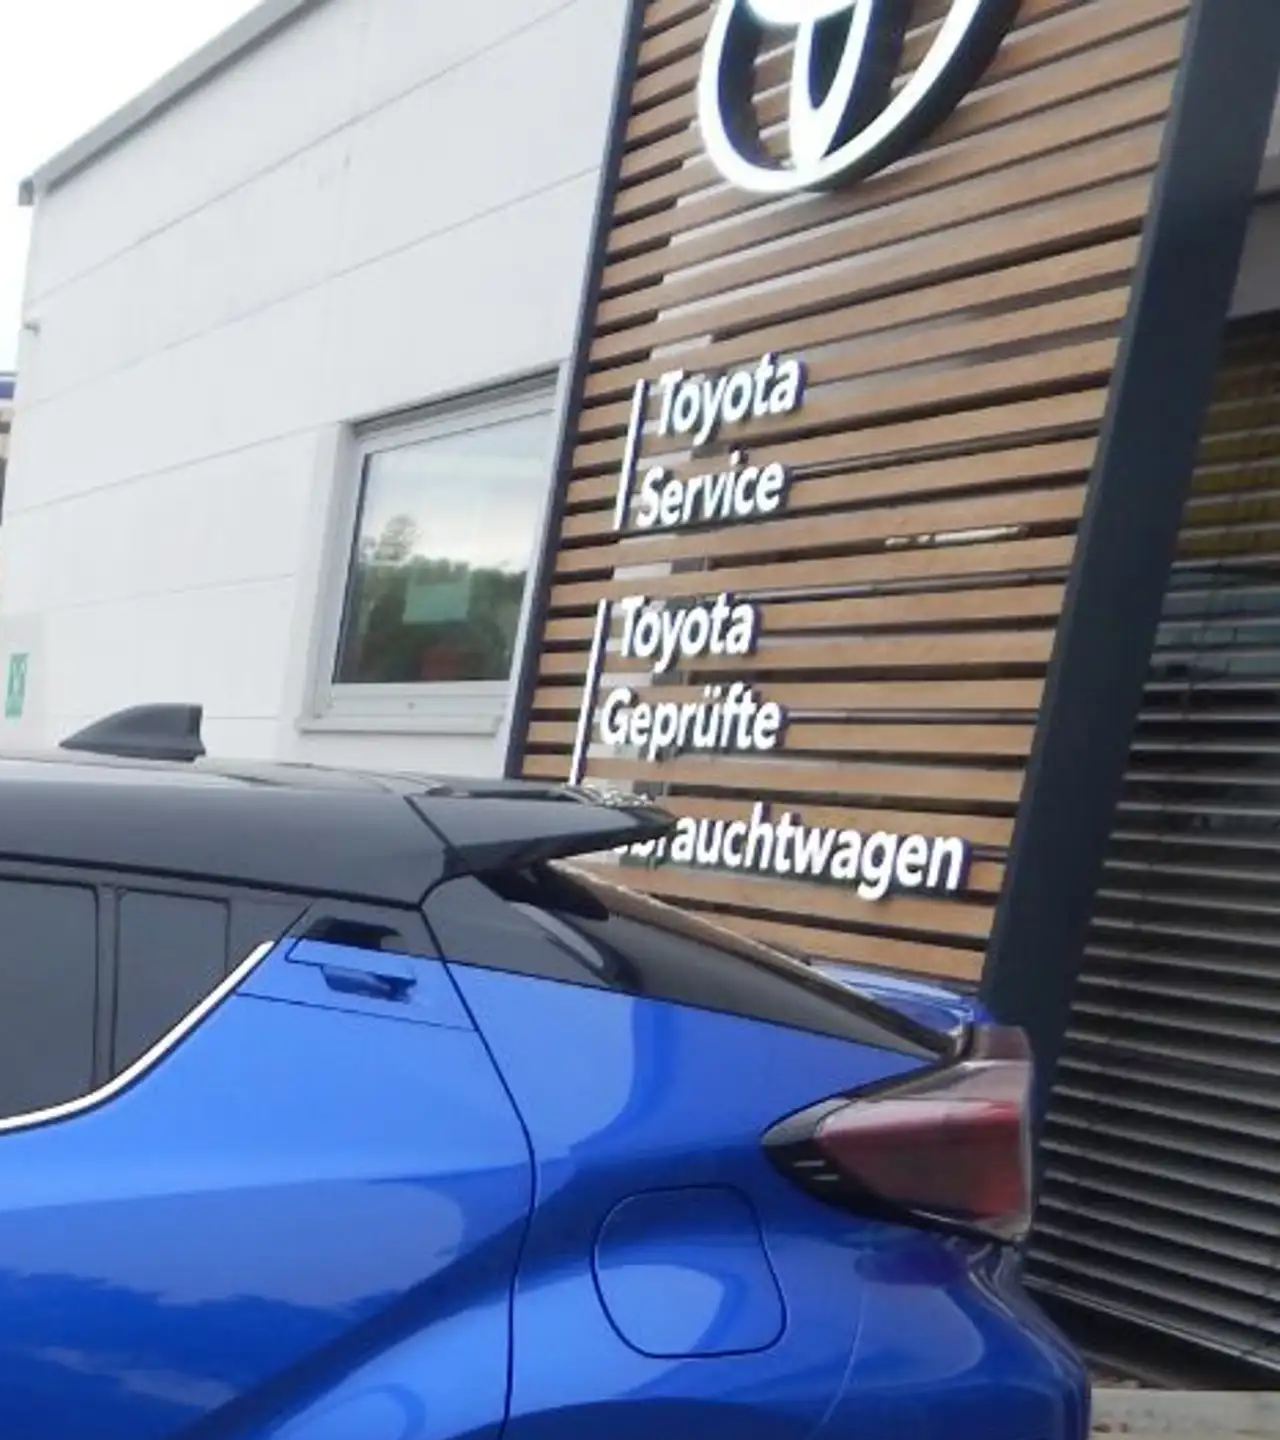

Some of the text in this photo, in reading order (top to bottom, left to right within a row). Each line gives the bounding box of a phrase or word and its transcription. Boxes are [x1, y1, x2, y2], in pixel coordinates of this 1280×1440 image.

[655, 351, 803, 445] Toyota
[635, 451, 786, 528] Service
[619, 592, 755, 672] Toyota
[598, 684, 782, 762] Geprüfte
